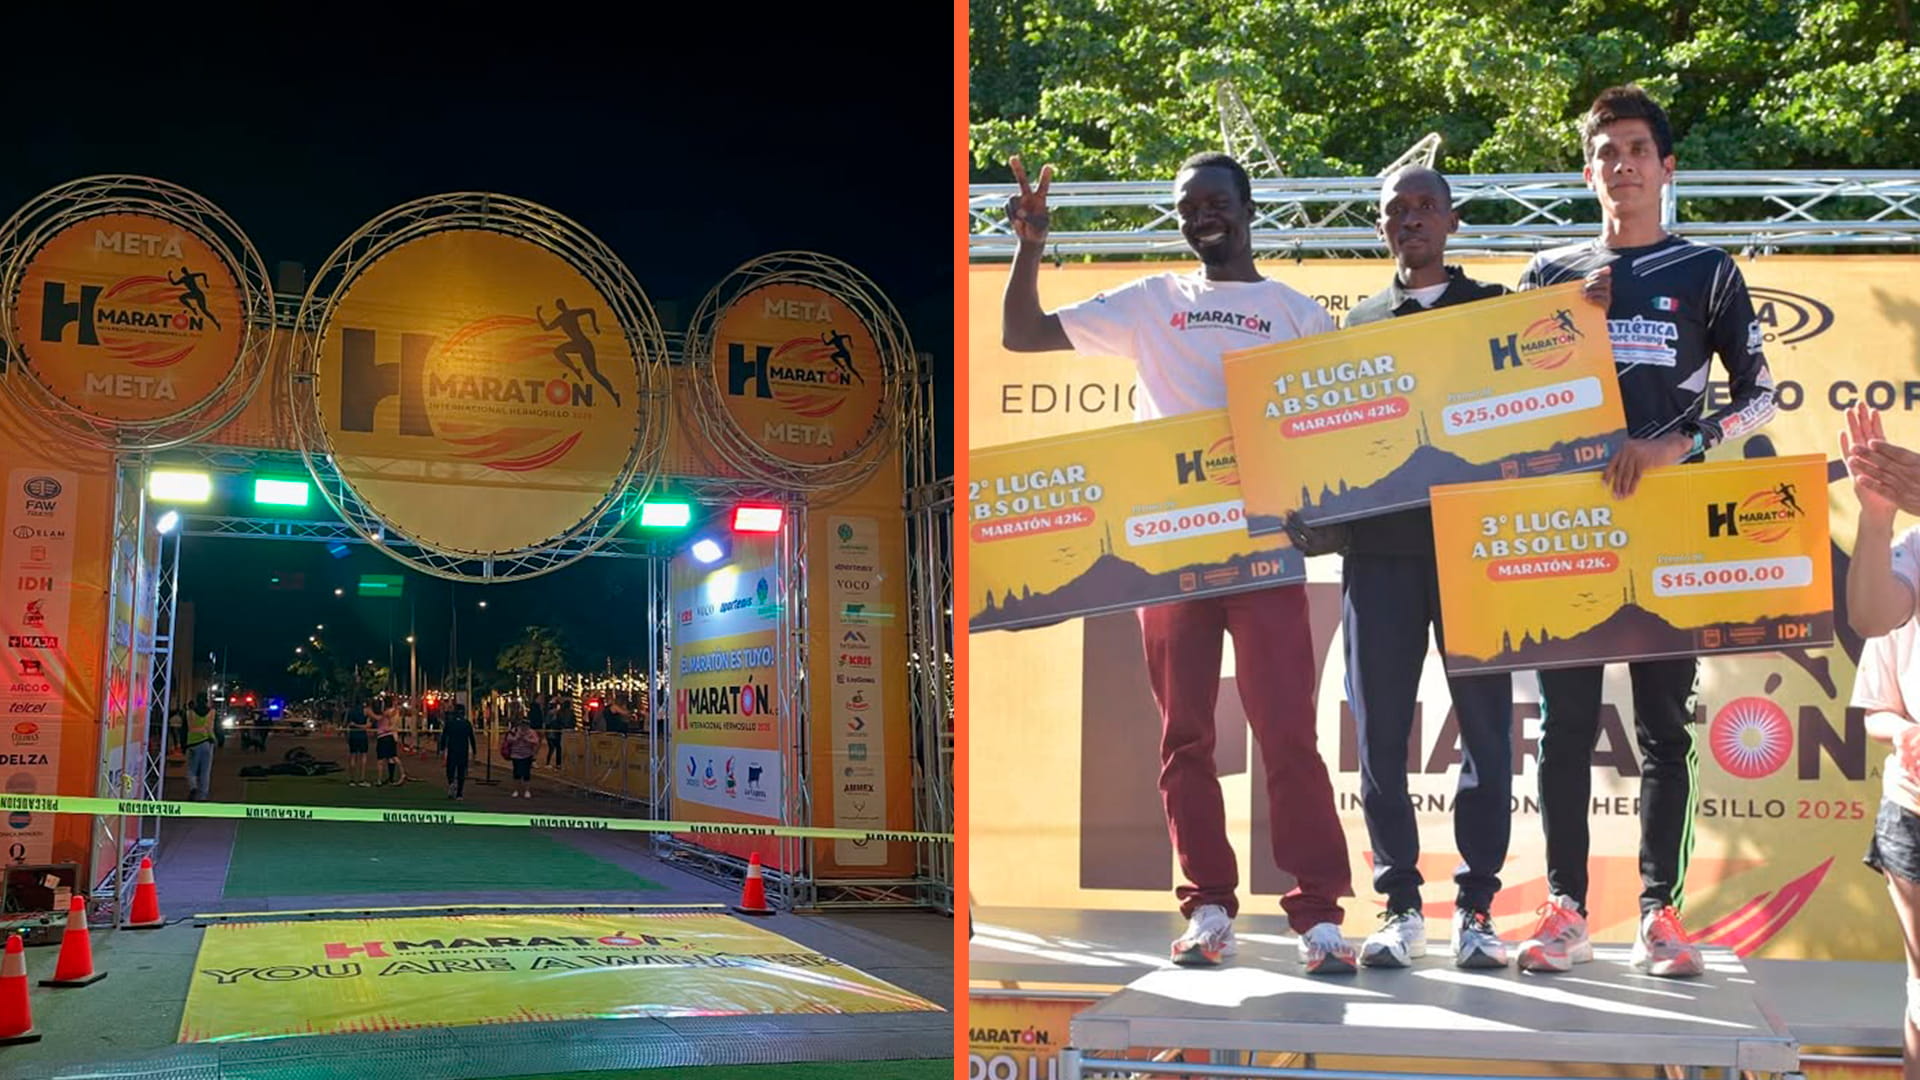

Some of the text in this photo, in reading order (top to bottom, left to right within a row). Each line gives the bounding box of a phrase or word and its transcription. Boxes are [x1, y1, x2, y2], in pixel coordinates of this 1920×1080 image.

[94, 230, 184, 260] META
[97, 308, 204, 331] MARATÓN
[763, 298, 833, 322] META
[1188, 310, 1271, 333] MARATÓN
[770, 367, 849, 385] MARATÓN
[1302, 354, 1396, 390] LUGAR
[85, 373, 177, 400] META
[429, 372, 593, 407] MARATÓN
[1001, 382, 1137, 413] EDICI
[1265, 375, 1416, 418] ABSOLUTO
[1292, 404, 1401, 433] MARATÓN 42K.
[764, 421, 833, 446] META
[1574, 442, 1609, 464] IDH
[996, 465, 1086, 496] LUGAR
[26, 500, 56, 511] FAW
[969, 484, 1103, 521] BSOLUTO
[981, 511, 1088, 538] MARATÓN 42K.
[1515, 506, 1613, 535] LUGAR
[1471, 529, 1630, 560] ABSOLUTO
[1252, 557, 1284, 577] IDH
[1499, 555, 1611, 576] MARATÓN 42K.
[18, 576, 53, 591] IDH
[1778, 623, 1812, 640] IDH
[730, 651, 743, 670] ES
[9, 702, 47, 713] telcel
[689, 675, 768, 717] MARATÓN
[1593, 796, 1865, 820] HESILLO 2025
[202, 962, 362, 984] YOU
[379, 957, 516, 977] ARE
